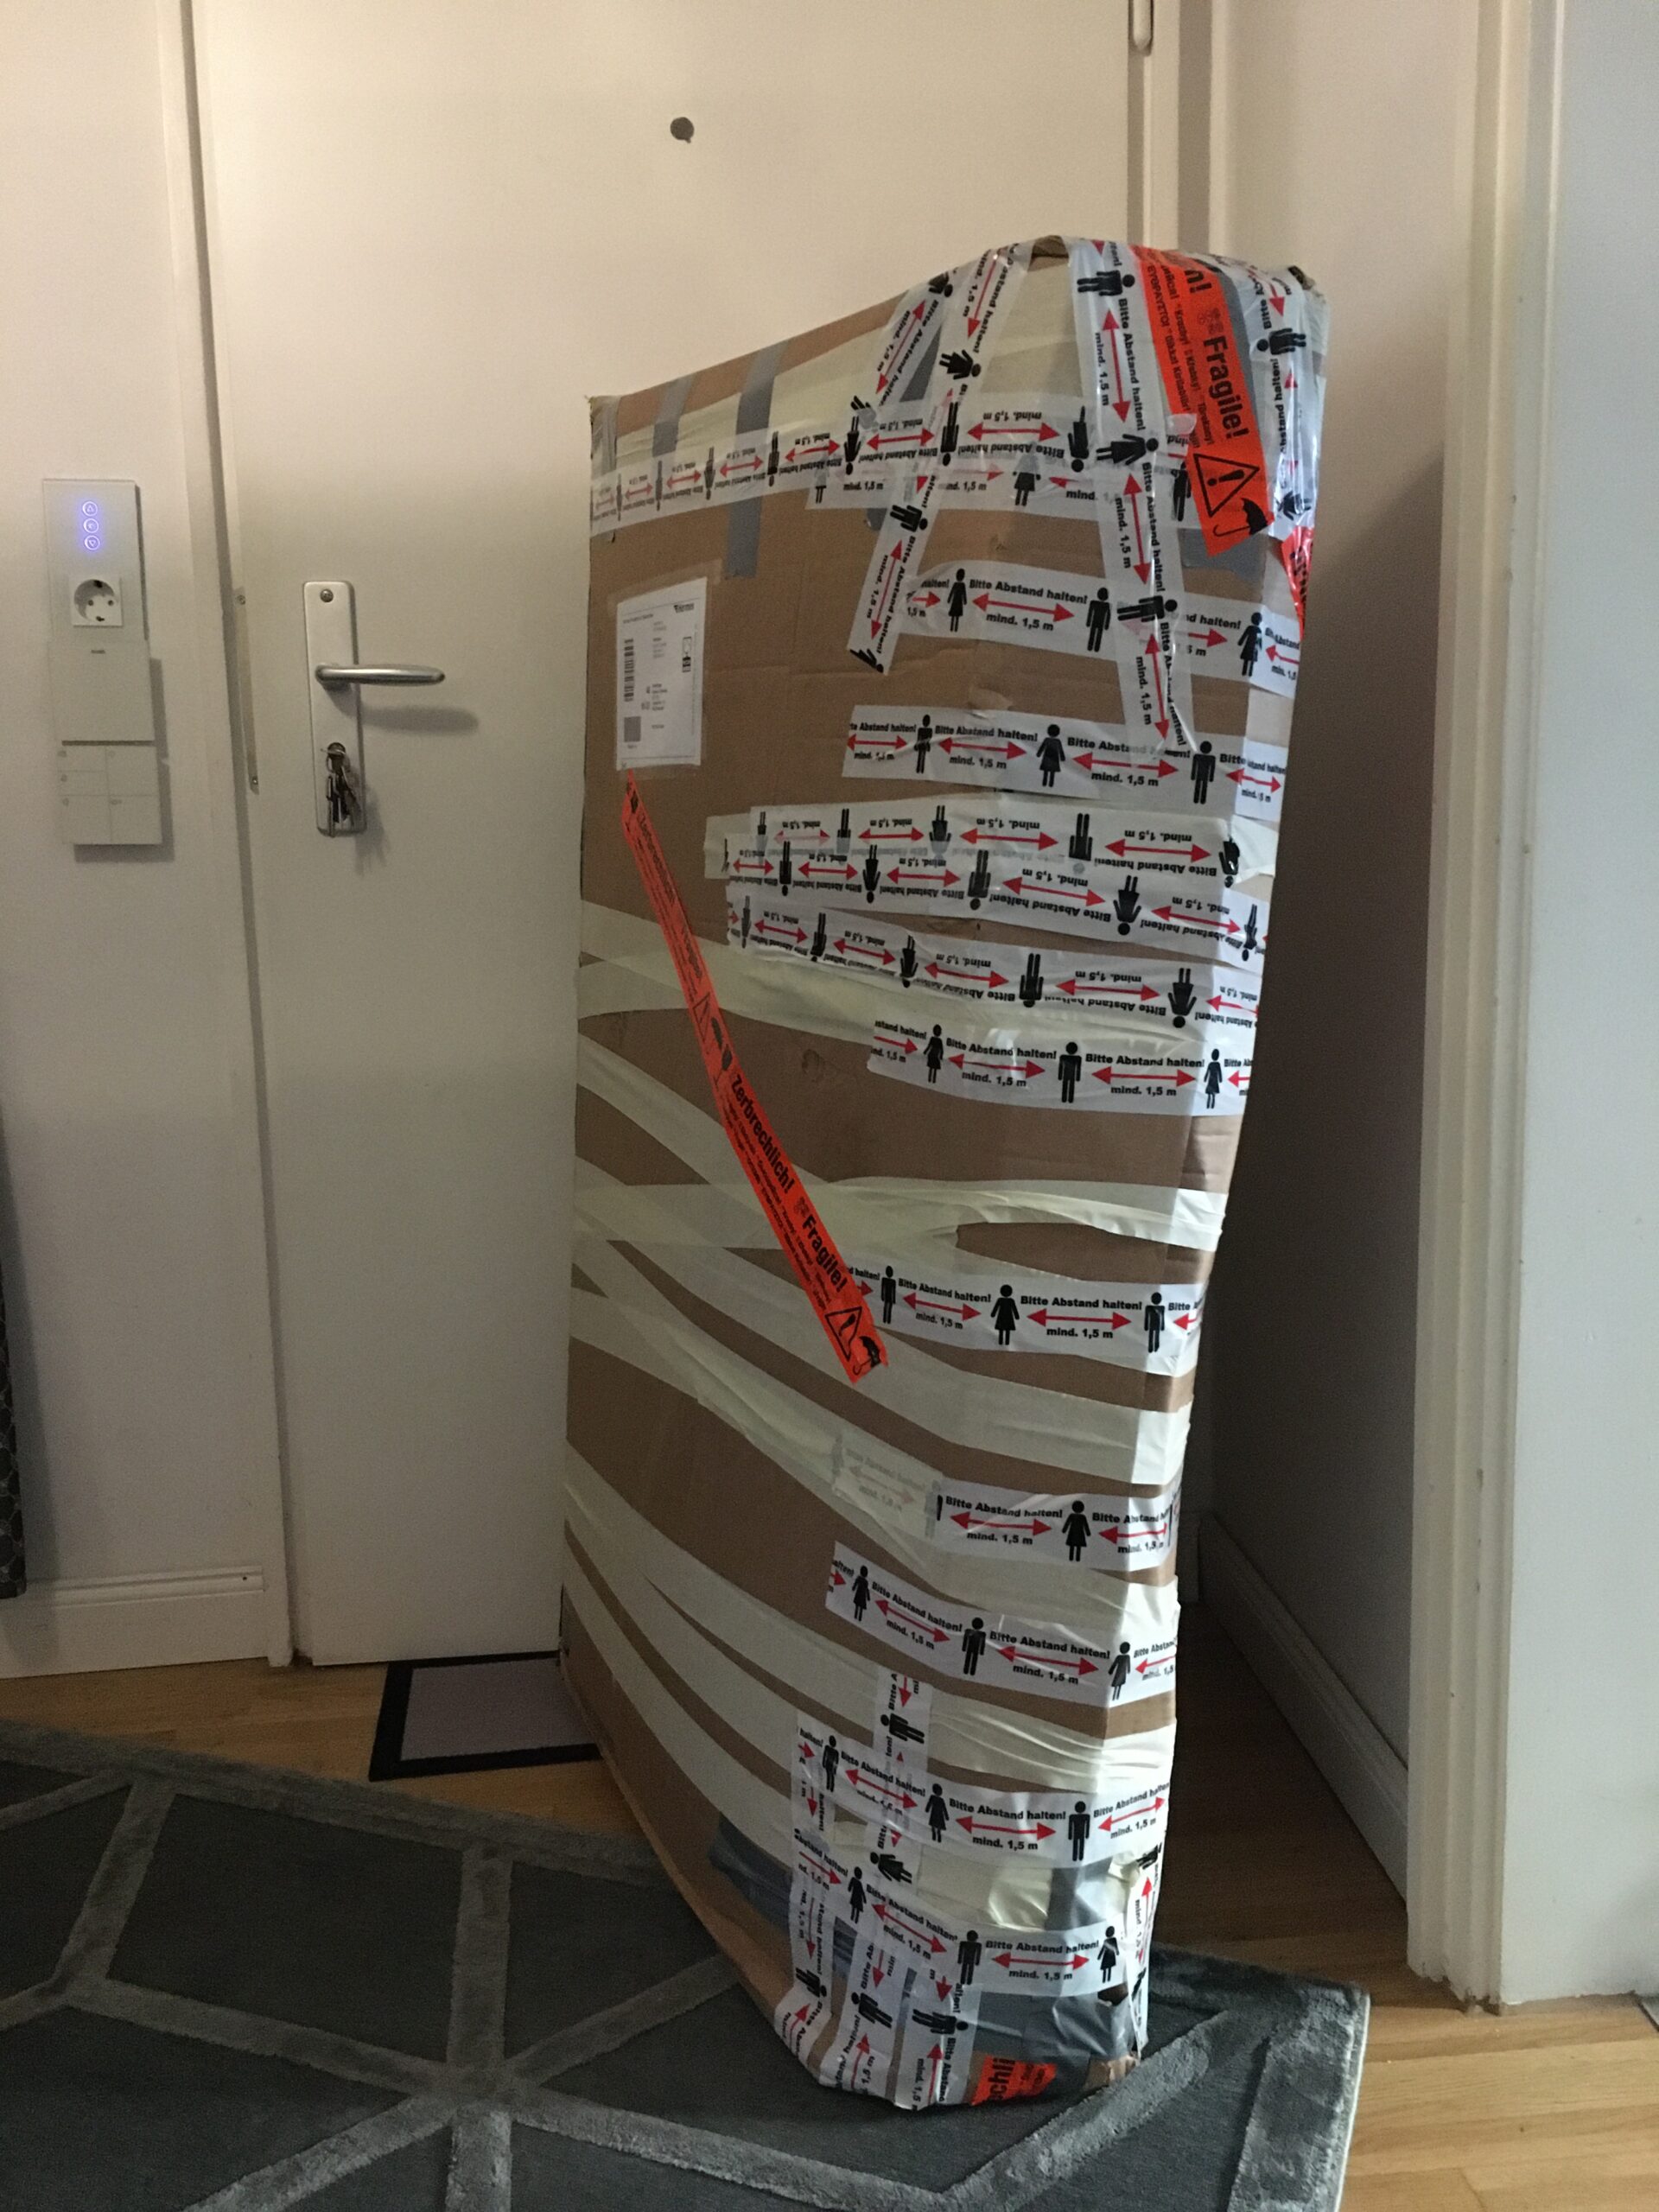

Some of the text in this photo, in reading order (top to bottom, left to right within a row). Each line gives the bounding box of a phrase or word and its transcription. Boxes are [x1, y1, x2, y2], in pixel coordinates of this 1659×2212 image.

[1260, 299, 1272, 329] Bitte
[1095, 332, 1109, 406] mind. 1,5 m
[1118, 298, 1146, 431] Bitte Abstand halten!
[1203, 334, 1249, 440] Fragile!
[995, 410, 1008, 422] 1,5
[1013, 411, 1042, 422] mind.
[991, 444, 1033, 453] Abstand
[1037, 445, 1065, 459] Bitte
[1115, 498, 1131, 569] mind. 1,5 m
[888, 566, 906, 613] Abstand
[969, 579, 1088, 604] Bitte Abstand halten!
[986, 613, 1054, 632] mind. 1,5 m
[1200, 615, 1241, 630] halten!
[1136, 656, 1152, 725] mind. 1,5 m
[935, 725, 1038, 742] Bitte Abstand halten!
[1067, 736, 1096, 749] Bitte
[950, 756, 1007, 770] mind. 1,5 m
[1091, 772, 1159, 787] mind. 1,5 m
[988, 818, 1004, 829] 1,5
[1009, 820, 1039, 830] mind.
[1139, 830, 1155, 841] 1,5
[1160, 832, 1192, 843] mind.
[1138, 861, 1217, 876] Bitte Abstand
[1036, 871, 1052, 882] 1,5
[1057, 874, 1089, 887] mind.
[989, 893, 1111, 923] Bitte Abstand halten!
[1172, 896, 1202, 910] 1,5 m
[947, 956, 959, 965] 1,5
[963, 957, 992, 968] mind.
[1089, 971, 1106, 982] 1,5
[1110, 974, 1141, 982] mind.
[1088, 998, 1166, 1016] Bitte Abstand
[946, 1038, 1057, 1059] Bitte Abstand halten!
[1085, 1053, 1205, 1067] Bitte Abstand halten!
[1224, 1058, 1242, 1067] Bitte
[962, 1071, 991, 1084] mind.
[995, 1077, 1013, 1086] 1,5
[1110, 1085, 1142, 1095] mind.
[1146, 1087, 1162, 1096] 1,5
[731, 1074, 848, 1294] Zerbrechlich! Fragile!
[899, 1278, 992, 1303] Bitte Abstand halten!
[1020, 1295, 1142, 1311] Bitte Abstand halten!
[1168, 1302, 1191, 1311] Bitte
[916, 1312, 938, 1324] mind.
[940, 1317, 953, 1328] 1,5
[1046, 1327, 1078, 1337] mind.
[1082, 1329, 1099, 1339] 1,5
[945, 1496, 1063, 1518] Bitte Abstand halten!
[1092, 1512, 1121, 1523] Bitte
[967, 1531, 1033, 1546] mind. 1,5 m
[872, 1580, 963, 1632] Bitte Abstand halten!
[886, 1619, 935, 1649] mind. 1,5 m
[988, 1630, 1110, 1659] Bitte Abstand halten!
[1134, 1647, 1149, 1658] Bitte
[1013, 1663, 1079, 1685] mind. 1,5 m
[888, 1685, 897, 1710] Bitte
[949, 1798, 1065, 1820] Bitte Abstand halten!
[1093, 1790, 1147, 1818] Bitte Abstand
[1110, 1827, 1133, 1839] mind.
[1135, 1819, 1147, 1831] 1,5
[972, 1837, 1002, 1848] mind.
[1007, 1840, 1024, 1851] 1,5
[908, 1940, 921, 1953] 1,5
[923, 1949, 931, 1960] m
[986, 1940, 1099, 1954] Bitte Abstand halten!
[1009, 1970, 1039, 1979] mind.
[1044, 1972, 1060, 1981] 1,5
